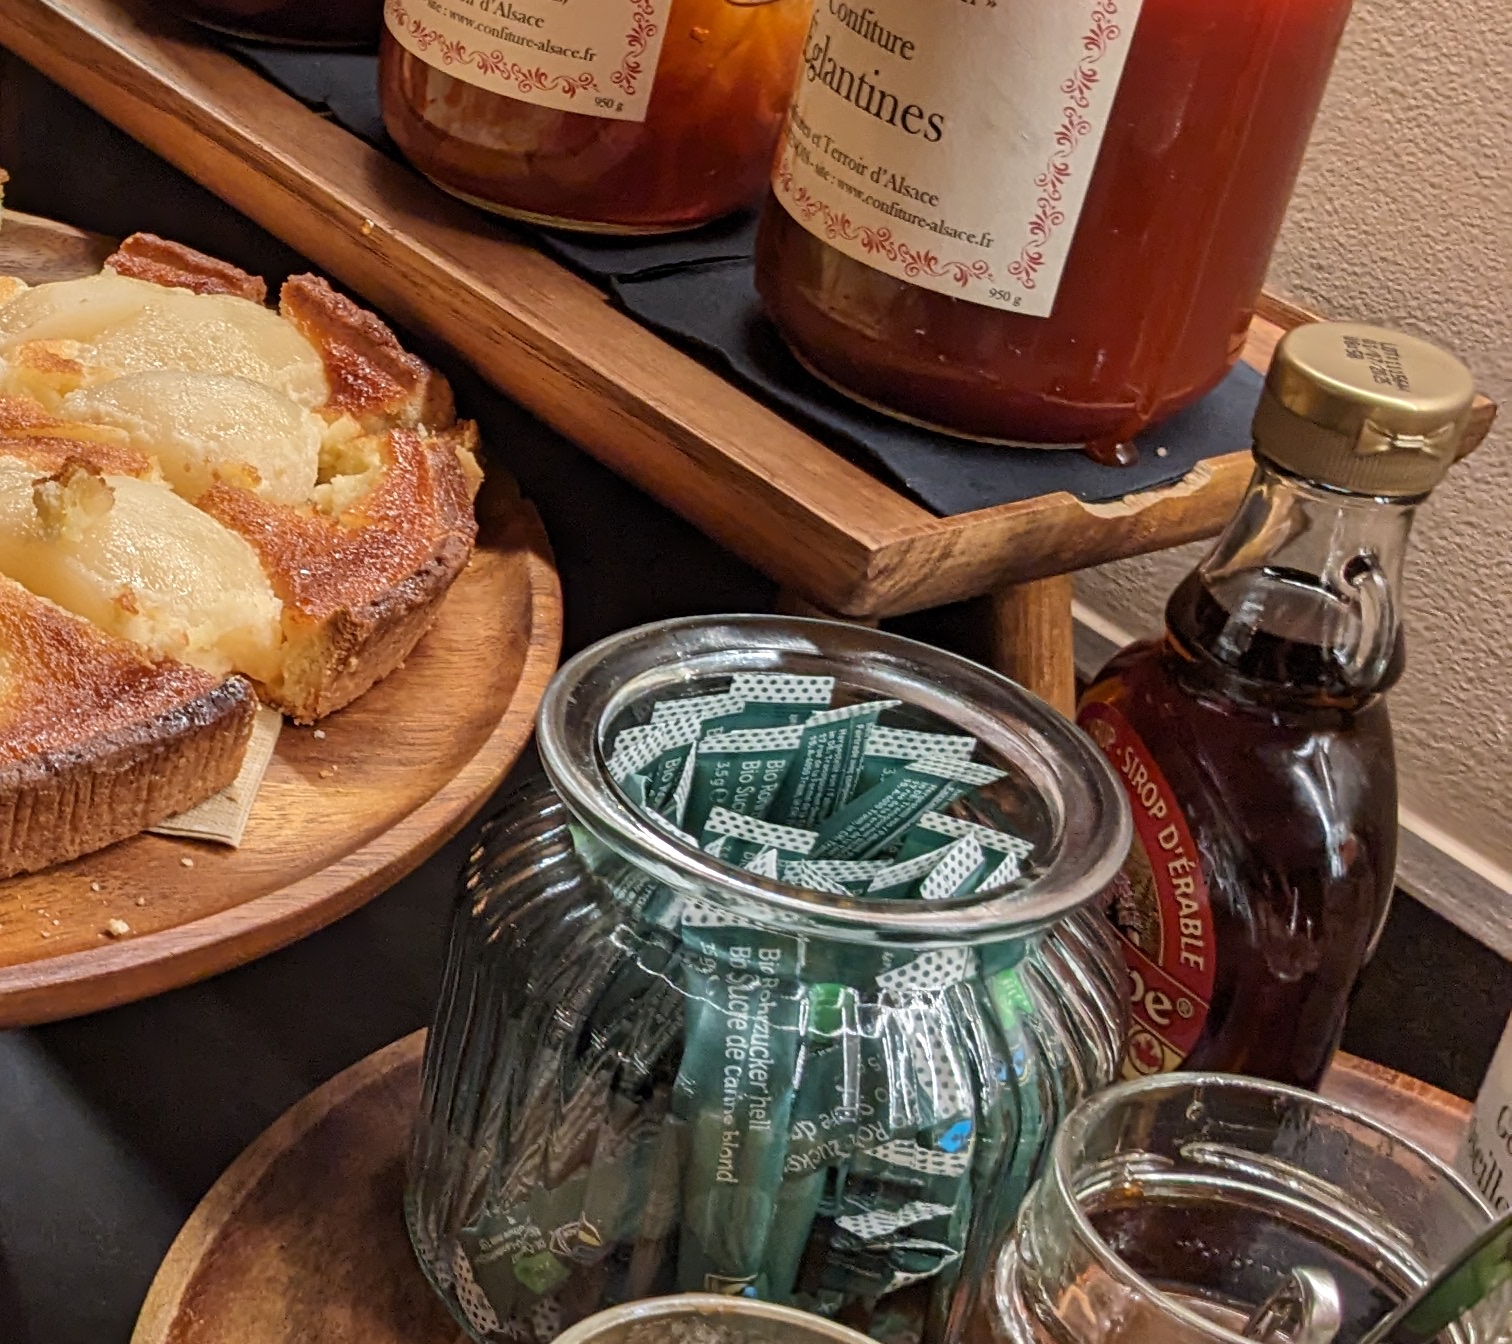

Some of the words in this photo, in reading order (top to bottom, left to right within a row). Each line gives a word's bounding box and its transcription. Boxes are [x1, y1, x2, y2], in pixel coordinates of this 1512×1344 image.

[449, 8, 597, 62] www.confiture-alsace.fr
[595, 95, 614, 109] 950
[615, 101, 623, 112] g
[823, 134, 867, 175] Terroir
[870, 167, 939, 207] d'Alsace
[837, 177, 994, 249] www.confiture-alsace.fr
[989, 288, 1011, 304] 950
[1013, 295, 1022, 307] g
[738, 760, 761, 784] Bio
[767, 759, 786, 782] Bio
[1120, 747, 1167, 820] SIROP
[1157, 825, 1205, 971] D'ÉRABLE
[725, 1035, 749, 1061] de
